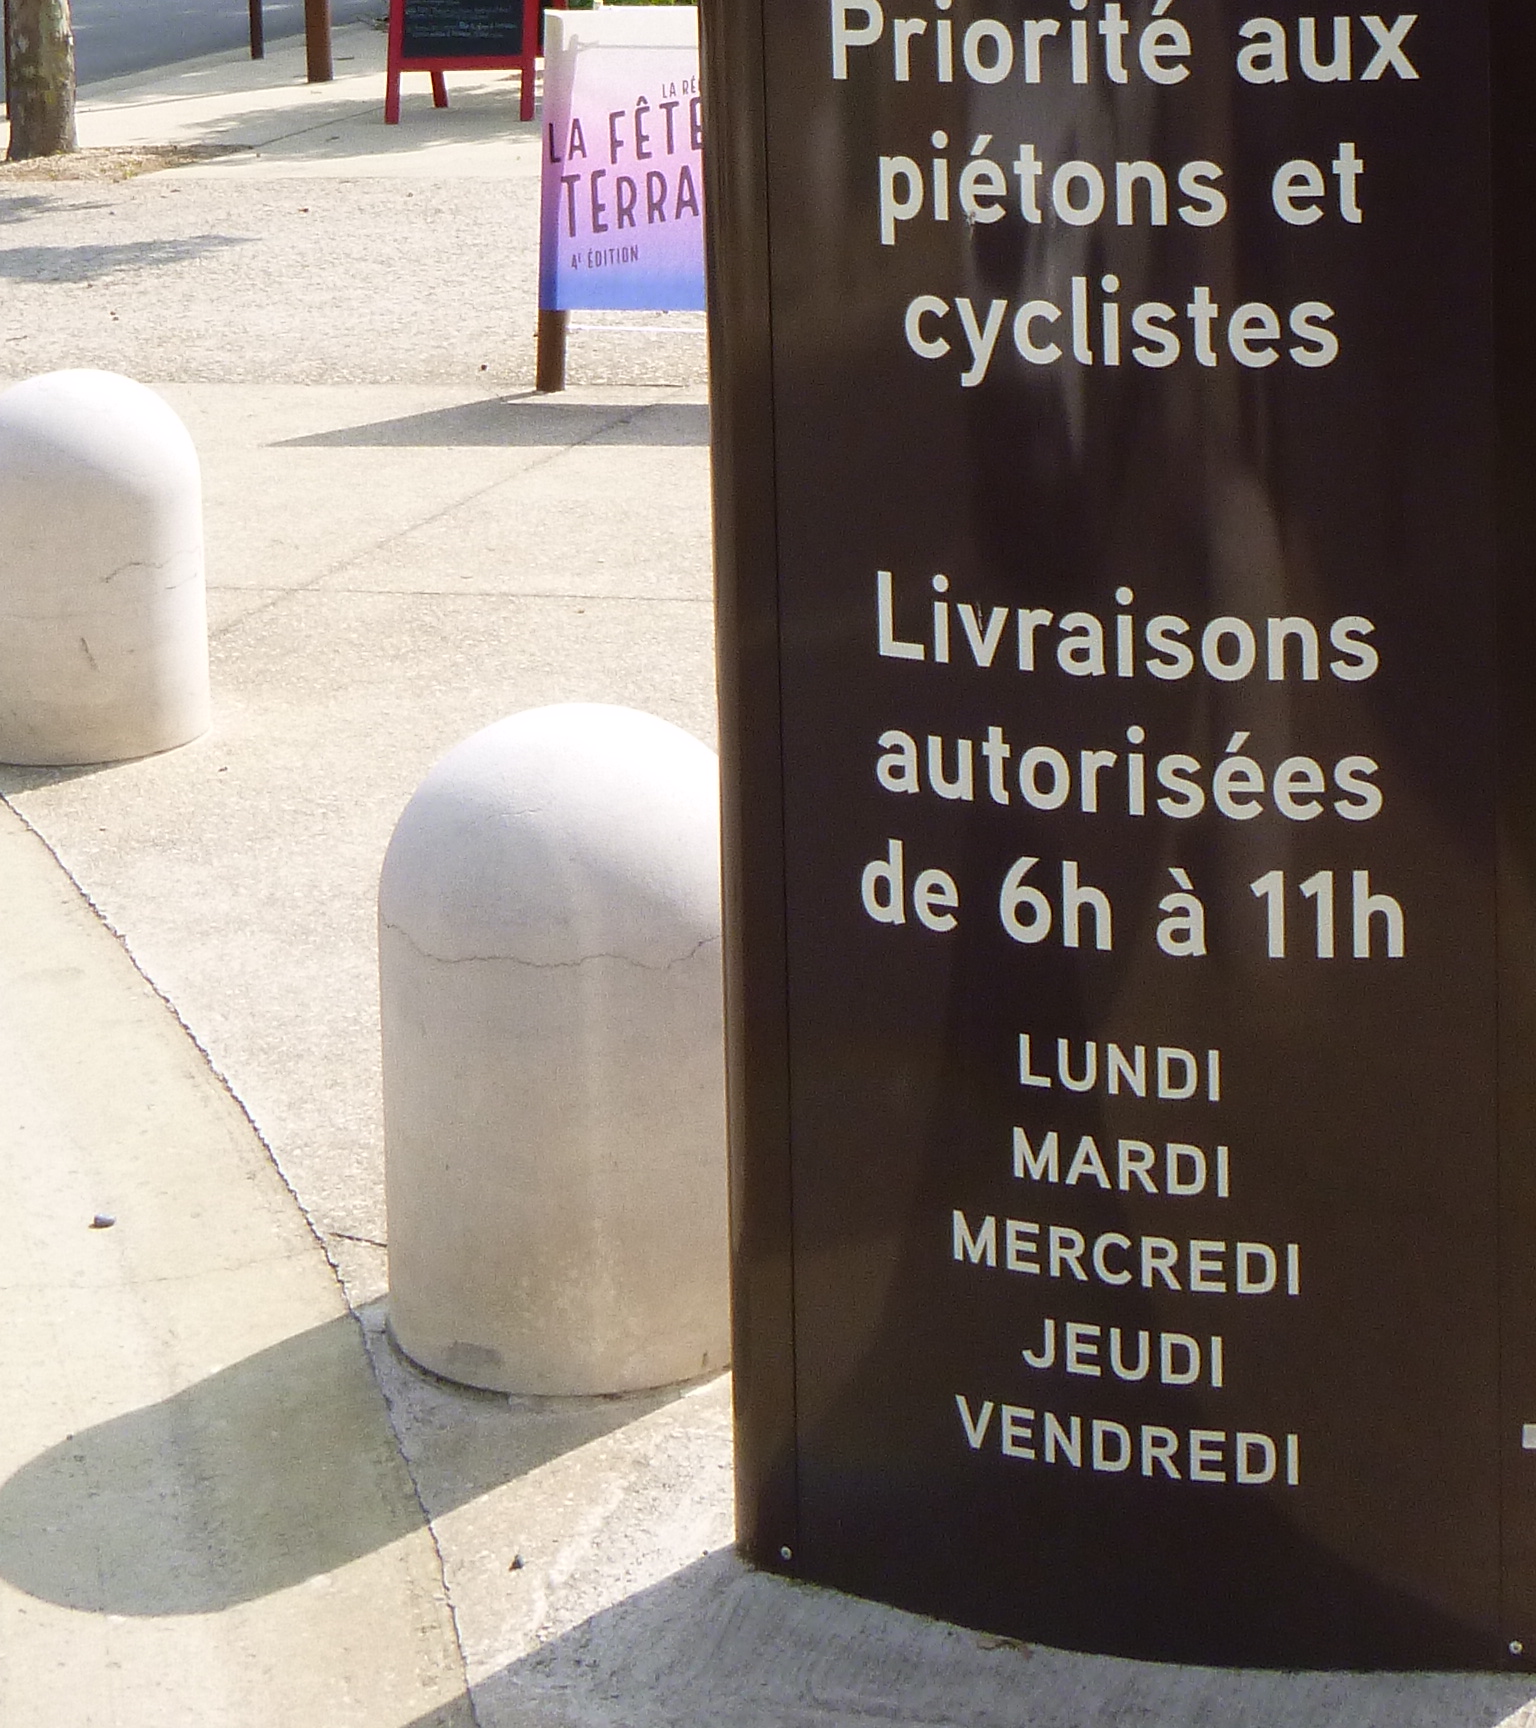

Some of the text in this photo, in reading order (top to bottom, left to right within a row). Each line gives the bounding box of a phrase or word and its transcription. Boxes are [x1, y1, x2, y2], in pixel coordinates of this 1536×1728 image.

[1237, 13, 1419, 83] aux
[662, 81, 677, 99] LA
[548, 118, 587, 164] LA
[878, 130, 1365, 246] piétons et
[587, 245, 639, 269] ÉDITION
[904, 275, 1339, 388] cyclistes
[876, 570, 1380, 683] Livraisons
[876, 725, 1383, 823] autorisées
[861, 838, 1406, 959] de 6h à 11h
[1018, 1032, 1221, 1102] LUNDI
[1012, 1126, 1231, 1198] MARDI
[952, 1209, 1300, 1295] MERCREDI
[1022, 1318, 1224, 1389] JEUDI
[955, 1394, 1300, 1486] VENDREDI
